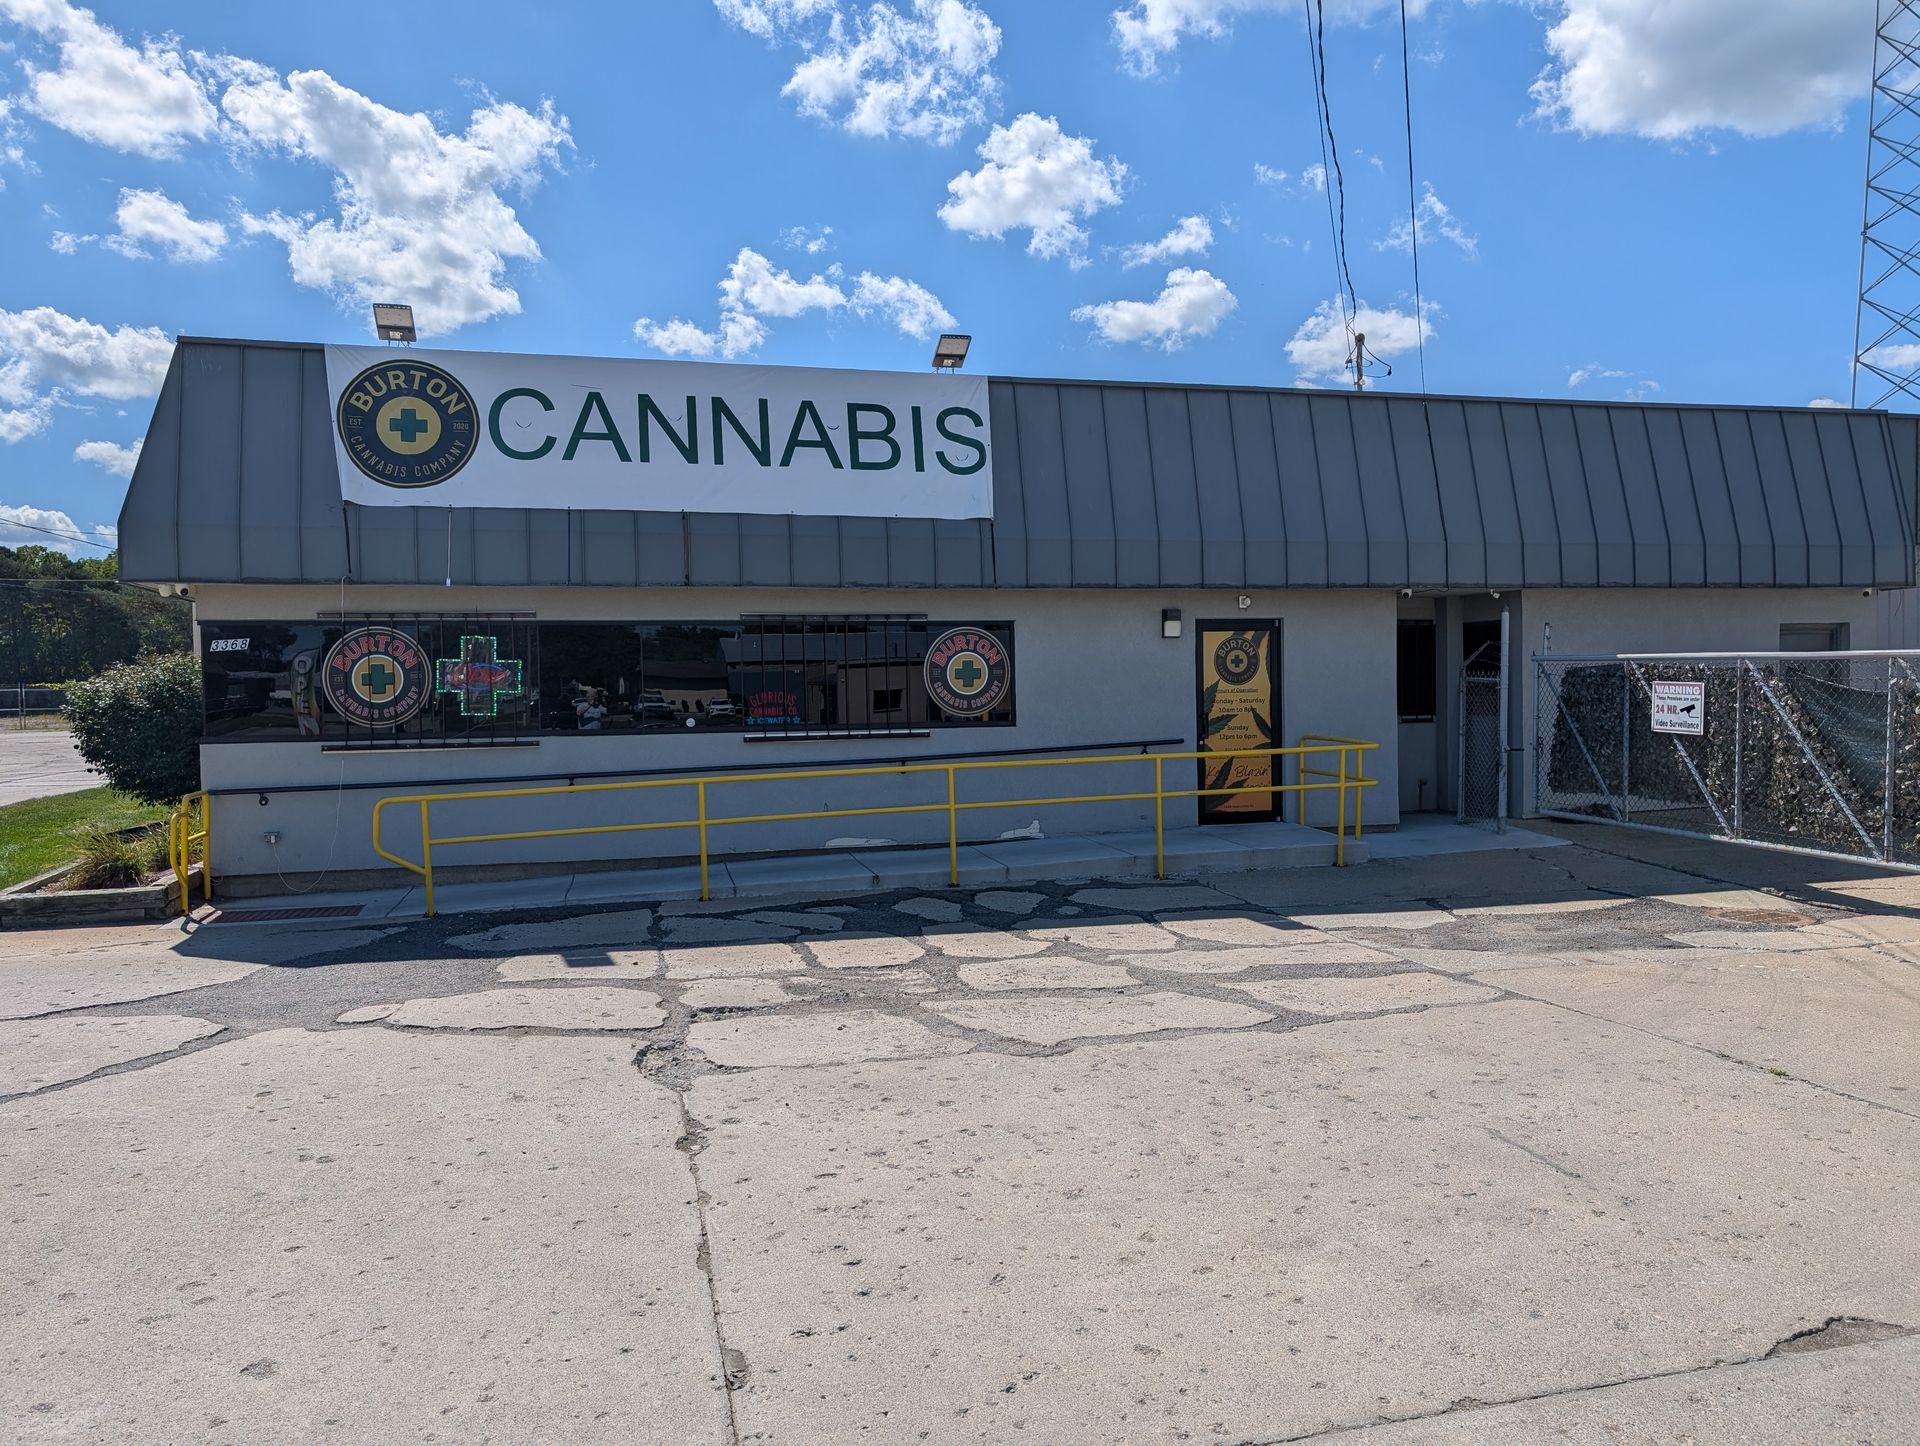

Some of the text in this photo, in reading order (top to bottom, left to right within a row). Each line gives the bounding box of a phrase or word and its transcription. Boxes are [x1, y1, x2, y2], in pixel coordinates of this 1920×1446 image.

[349, 370, 467, 415] BURTON
[453, 422, 469, 430] 2020
[488, 387, 987, 475] CANNABIS
[350, 435, 466, 478] CANNABIS COMPANY
[212, 640, 248, 650] 3368
[332, 635, 418, 672] BURTON
[931, 634, 1003, 668] BURTON
[1218, 639, 1256, 657] BURTON
[749, 690, 798, 707] GLORIOUS
[970, 680, 1002, 708] COMPANY
[1656, 685, 1700, 695] WARNING
[383, 686, 419, 718] COMPANY
[1656, 704, 1680, 714] 24 HR.
[1655, 719, 1700, 730] Video Surveillance
[1234, 765, 1270, 777] Blazin'
